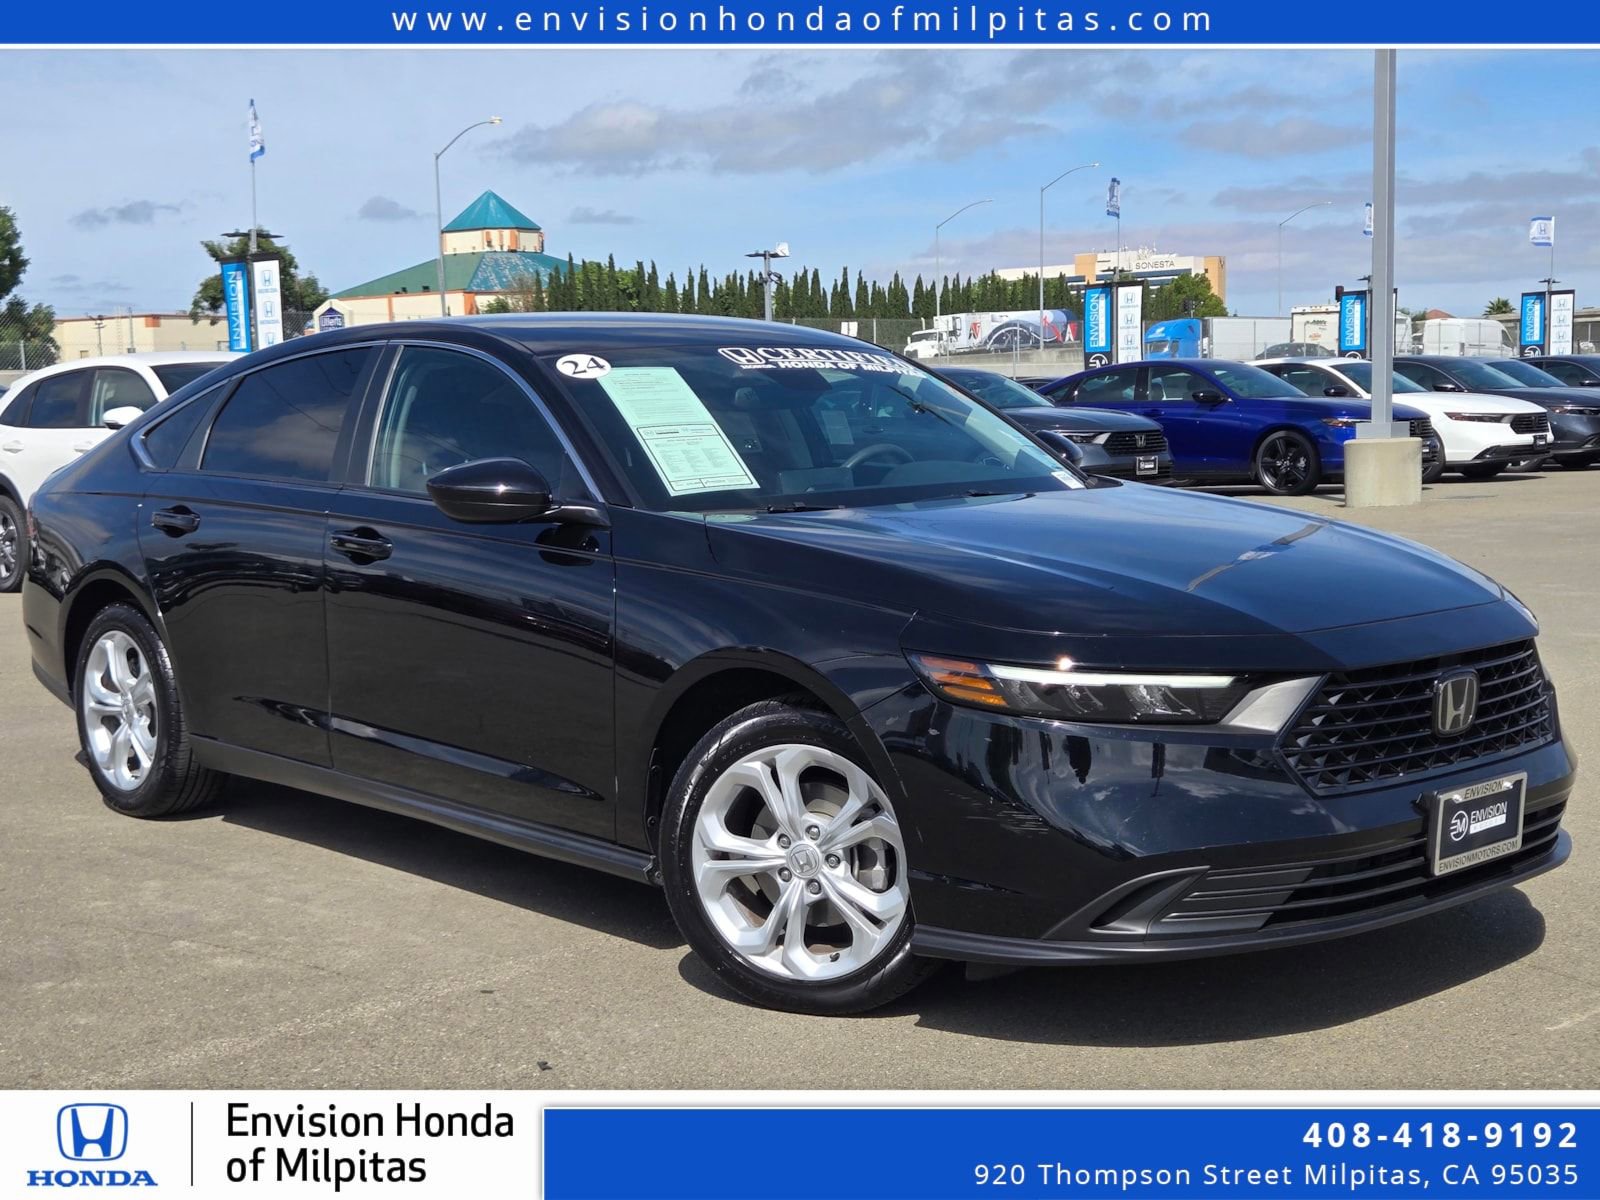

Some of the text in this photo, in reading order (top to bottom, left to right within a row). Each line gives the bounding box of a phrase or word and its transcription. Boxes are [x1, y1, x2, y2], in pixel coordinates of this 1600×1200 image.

[1135, 260, 1176, 271] SONESTA
[227, 271, 241, 350] ENVISION
[1090, 293, 1099, 348] ENVISION
[1345, 299, 1355, 346] ENVISION
[1526, 299, 1536, 342] ENVISION
[561, 356, 607, 376] 24
[777, 360, 838, 369] HONDA
[840, 361, 859, 370] OF
[1464, 780, 1504, 800] ENVISION
[1470, 801, 1508, 824] ENVISION
[1439, 840, 1518, 872] ENVISIONMOTORS.COM
